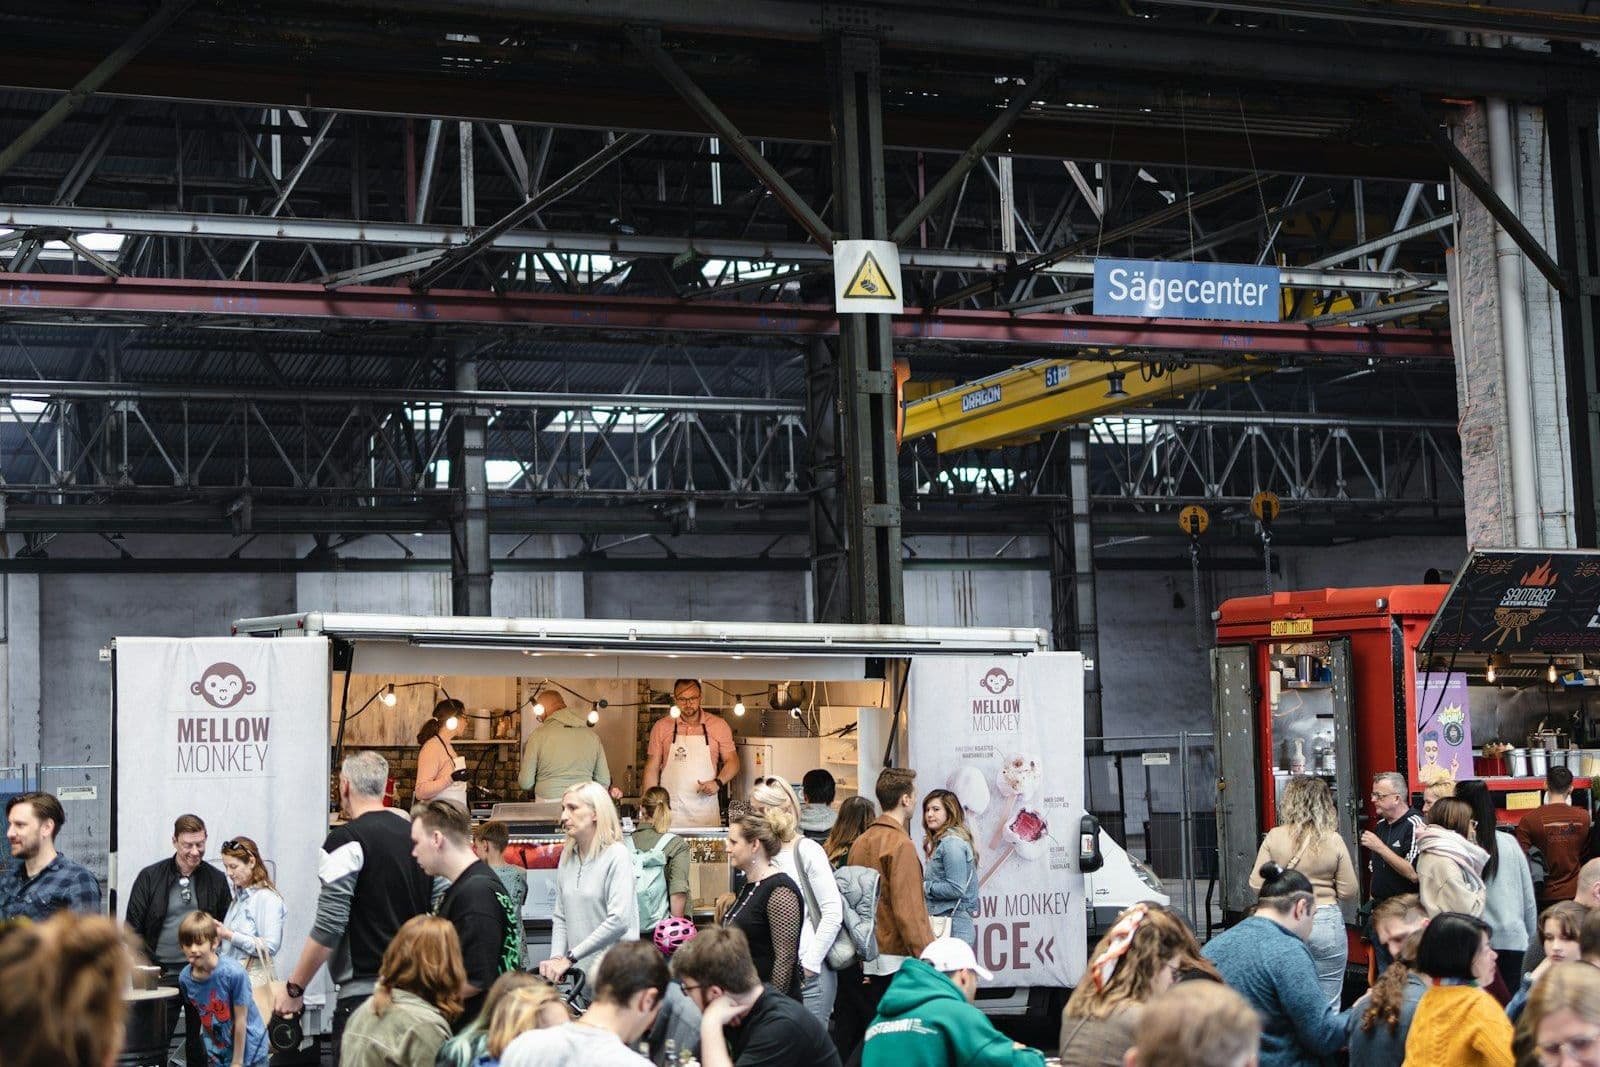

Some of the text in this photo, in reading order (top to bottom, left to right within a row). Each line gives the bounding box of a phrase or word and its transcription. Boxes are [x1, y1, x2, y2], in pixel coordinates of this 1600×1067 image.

[1108, 268, 1268, 310] Sägecenter
[962, 387, 1001, 411] DRAGON
[1503, 588, 1556, 602] SANTIAGO
[1272, 621, 1311, 634] FOOD TRUCK
[972, 699, 1020, 715] MELLOW
[178, 717, 270, 743] MELLOW
[972, 714, 1020, 732] MONKEY
[177, 743, 269, 773] MONKEY
[1005, 891, 1070, 917] MONKEY
